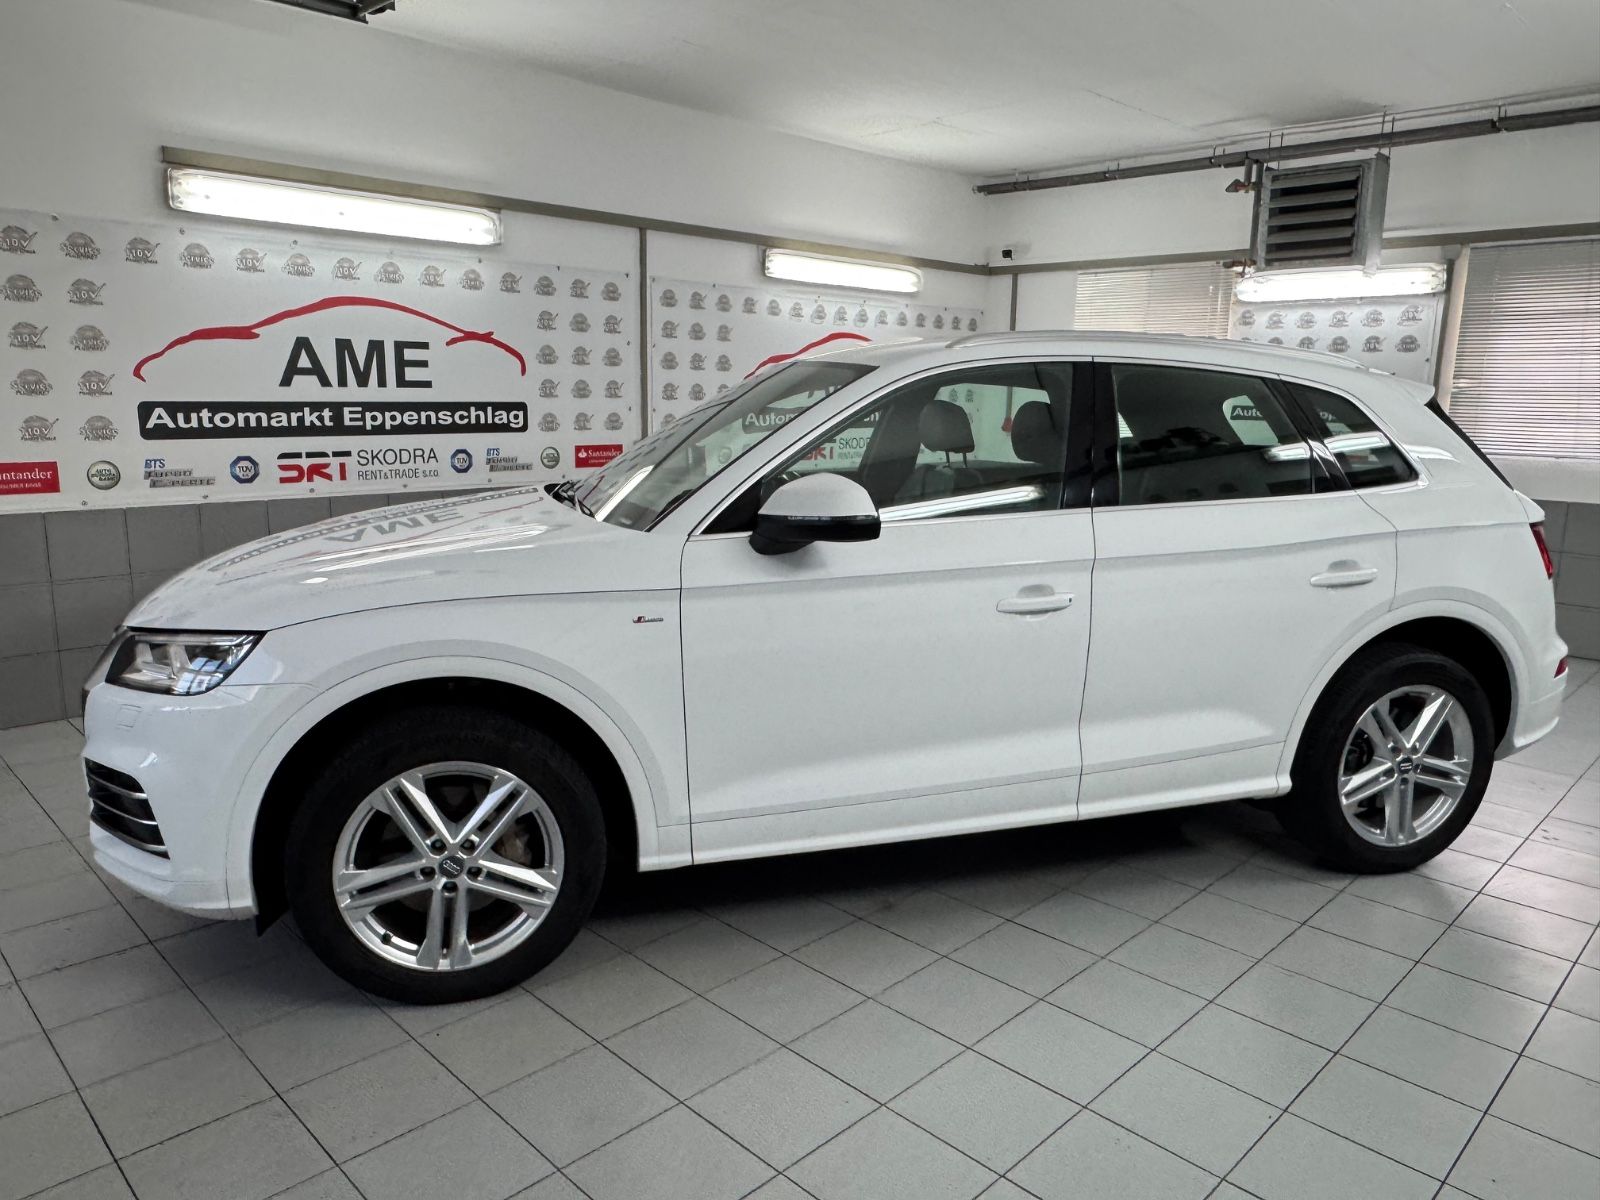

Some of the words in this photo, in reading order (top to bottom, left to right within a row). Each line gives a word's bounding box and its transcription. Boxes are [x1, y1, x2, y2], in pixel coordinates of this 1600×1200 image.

[279, 336, 432, 388] AME
[145, 407, 333, 429] Automarkt
[343, 406, 524, 430] Eppenschlag
[144, 458, 166, 469] BTS
[276, 450, 352, 484] SRT
[356, 447, 439, 466] SKODRA
[357, 468, 420, 481] RENT&TRADE
